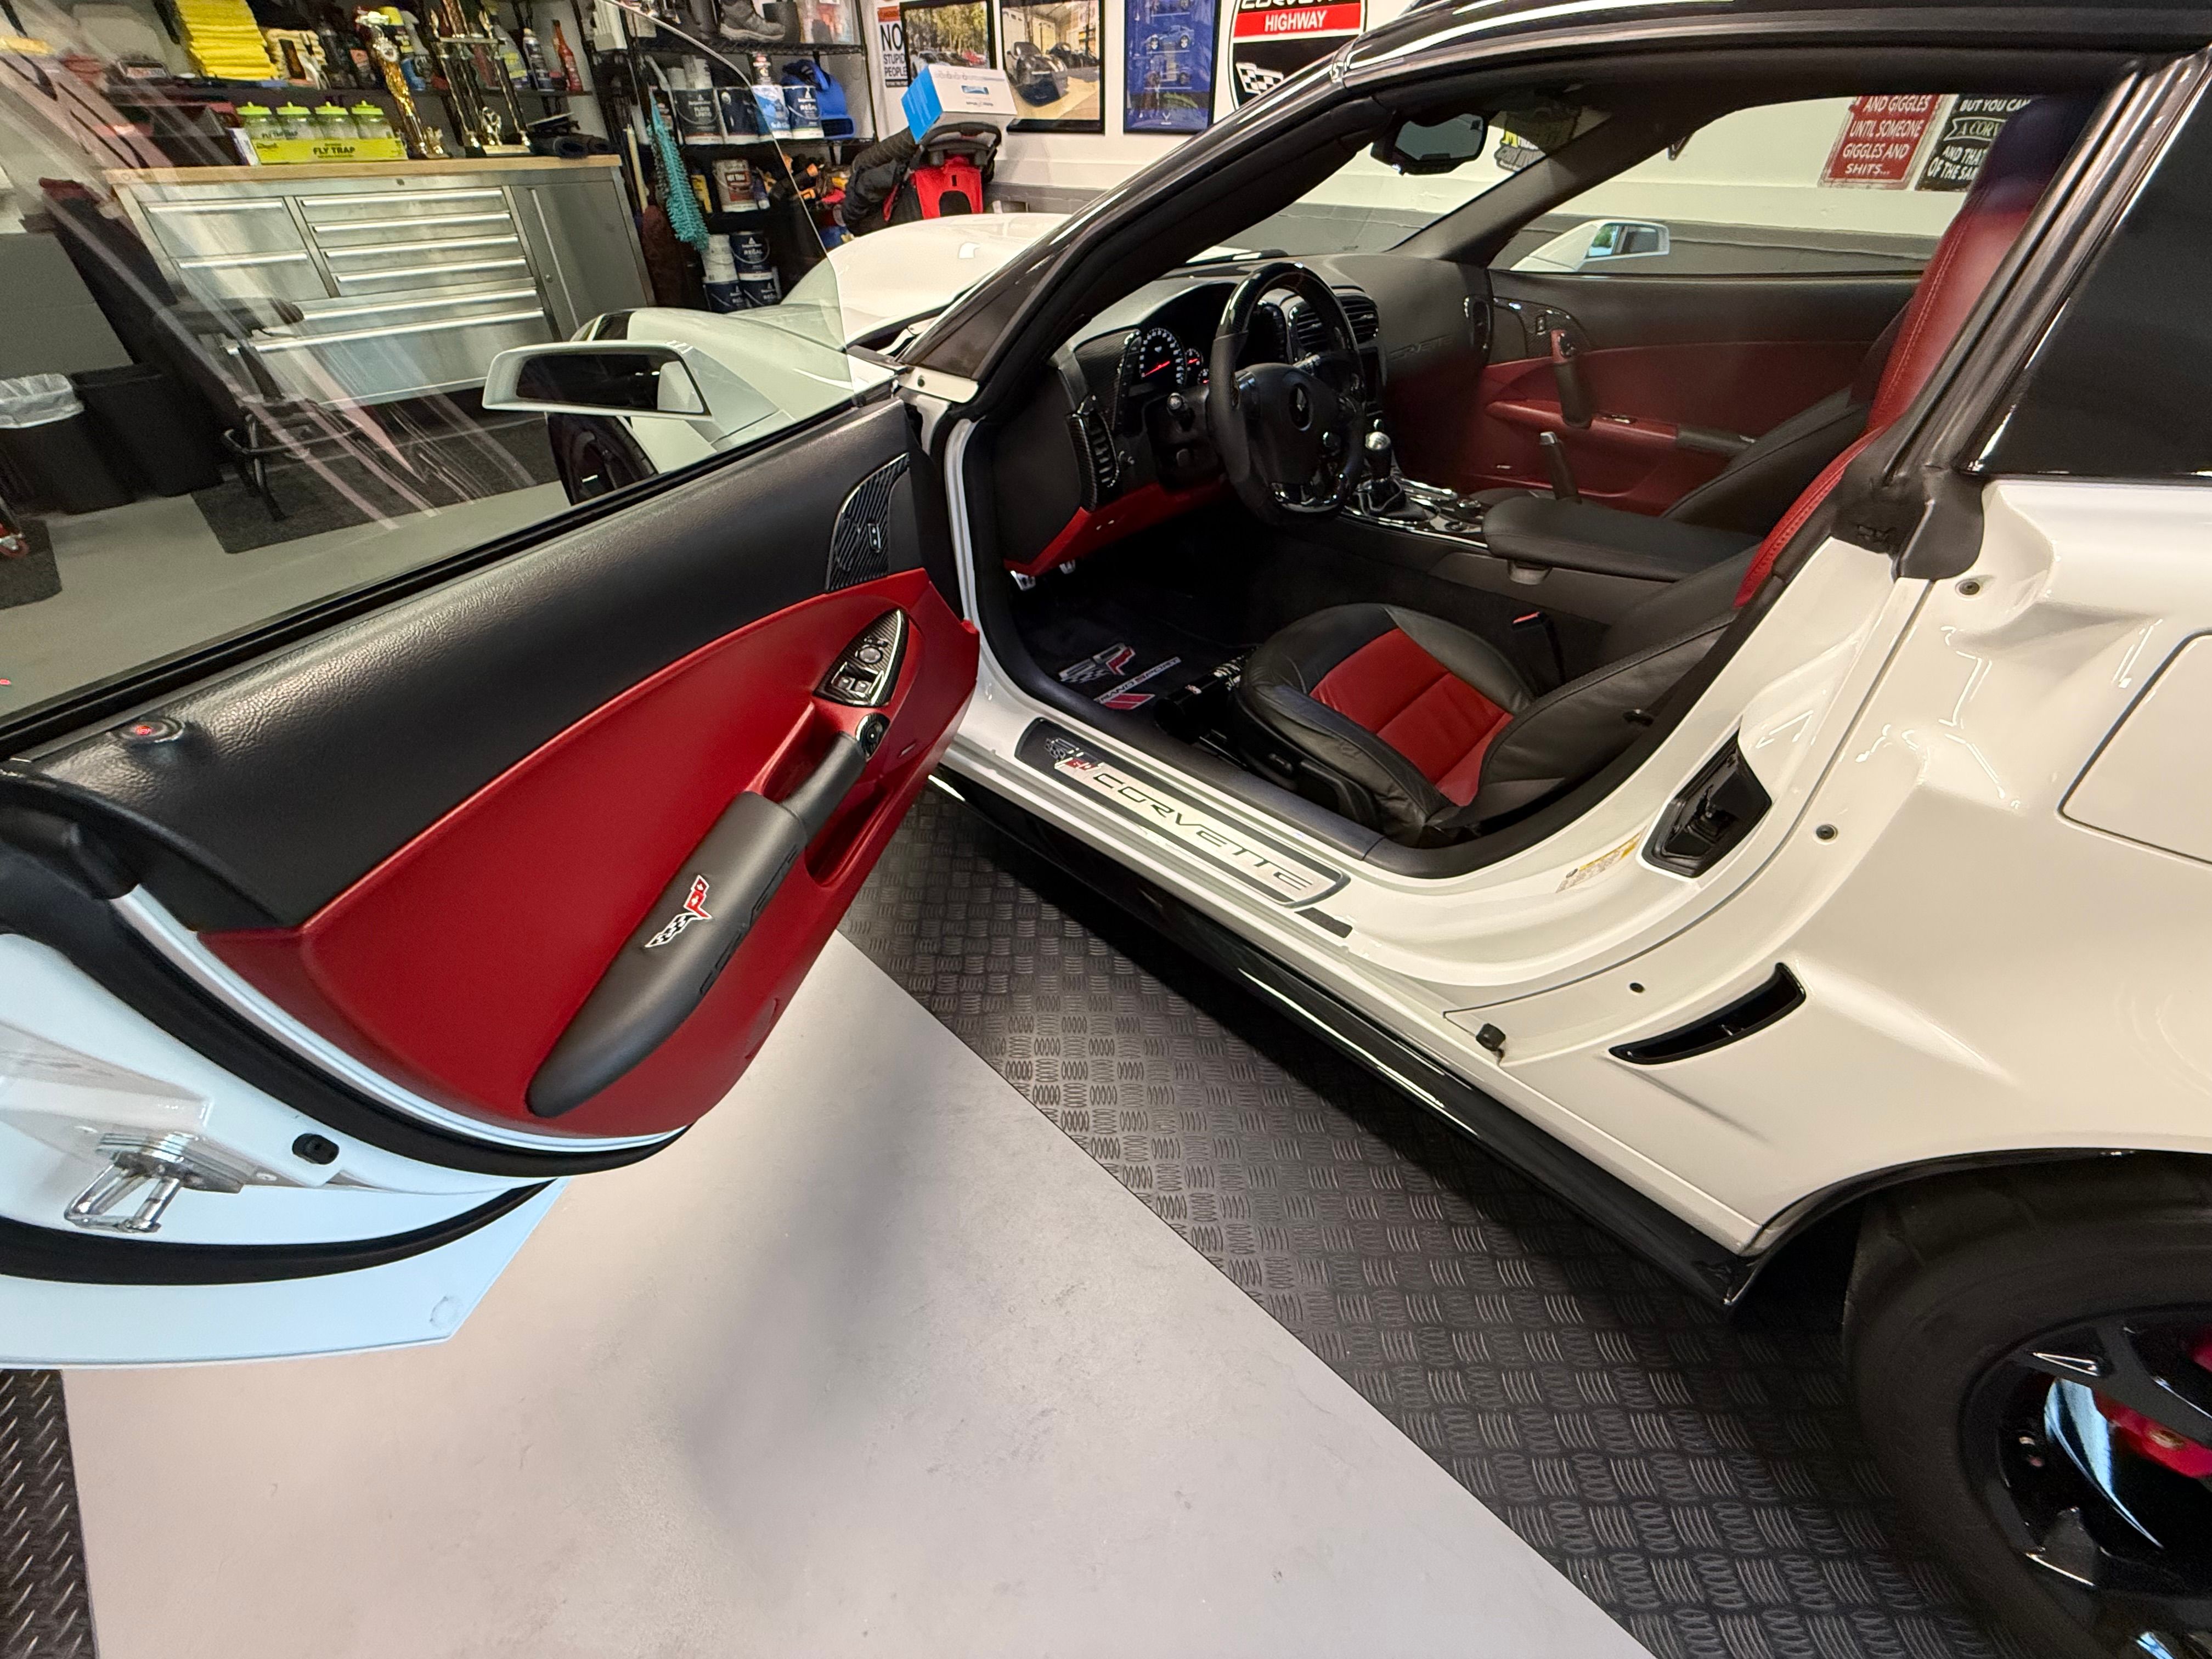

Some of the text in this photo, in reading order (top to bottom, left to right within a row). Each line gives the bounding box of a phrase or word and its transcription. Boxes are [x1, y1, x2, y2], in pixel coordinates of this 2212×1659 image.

[1265, 10, 1327, 32] HIGHWAY
[880, 23, 903, 51] NO
[884, 66, 908, 77] PEOPLE
[1863, 94, 1932, 113] AND GIGGLES
[1960, 99, 1984, 111] BUT
[1982, 99, 2007, 111] YOU
[1849, 119, 1925, 138] UNTIL SOMEONE
[1843, 143, 1910, 160] GIGGLES AND
[1943, 145, 1963, 161] AND
[1845, 163, 1890, 175] SHITS...
[1927, 156, 1945, 177] OF
[1940, 161, 1961, 180] THE
[1093, 772, 1313, 890] CORVETTE
